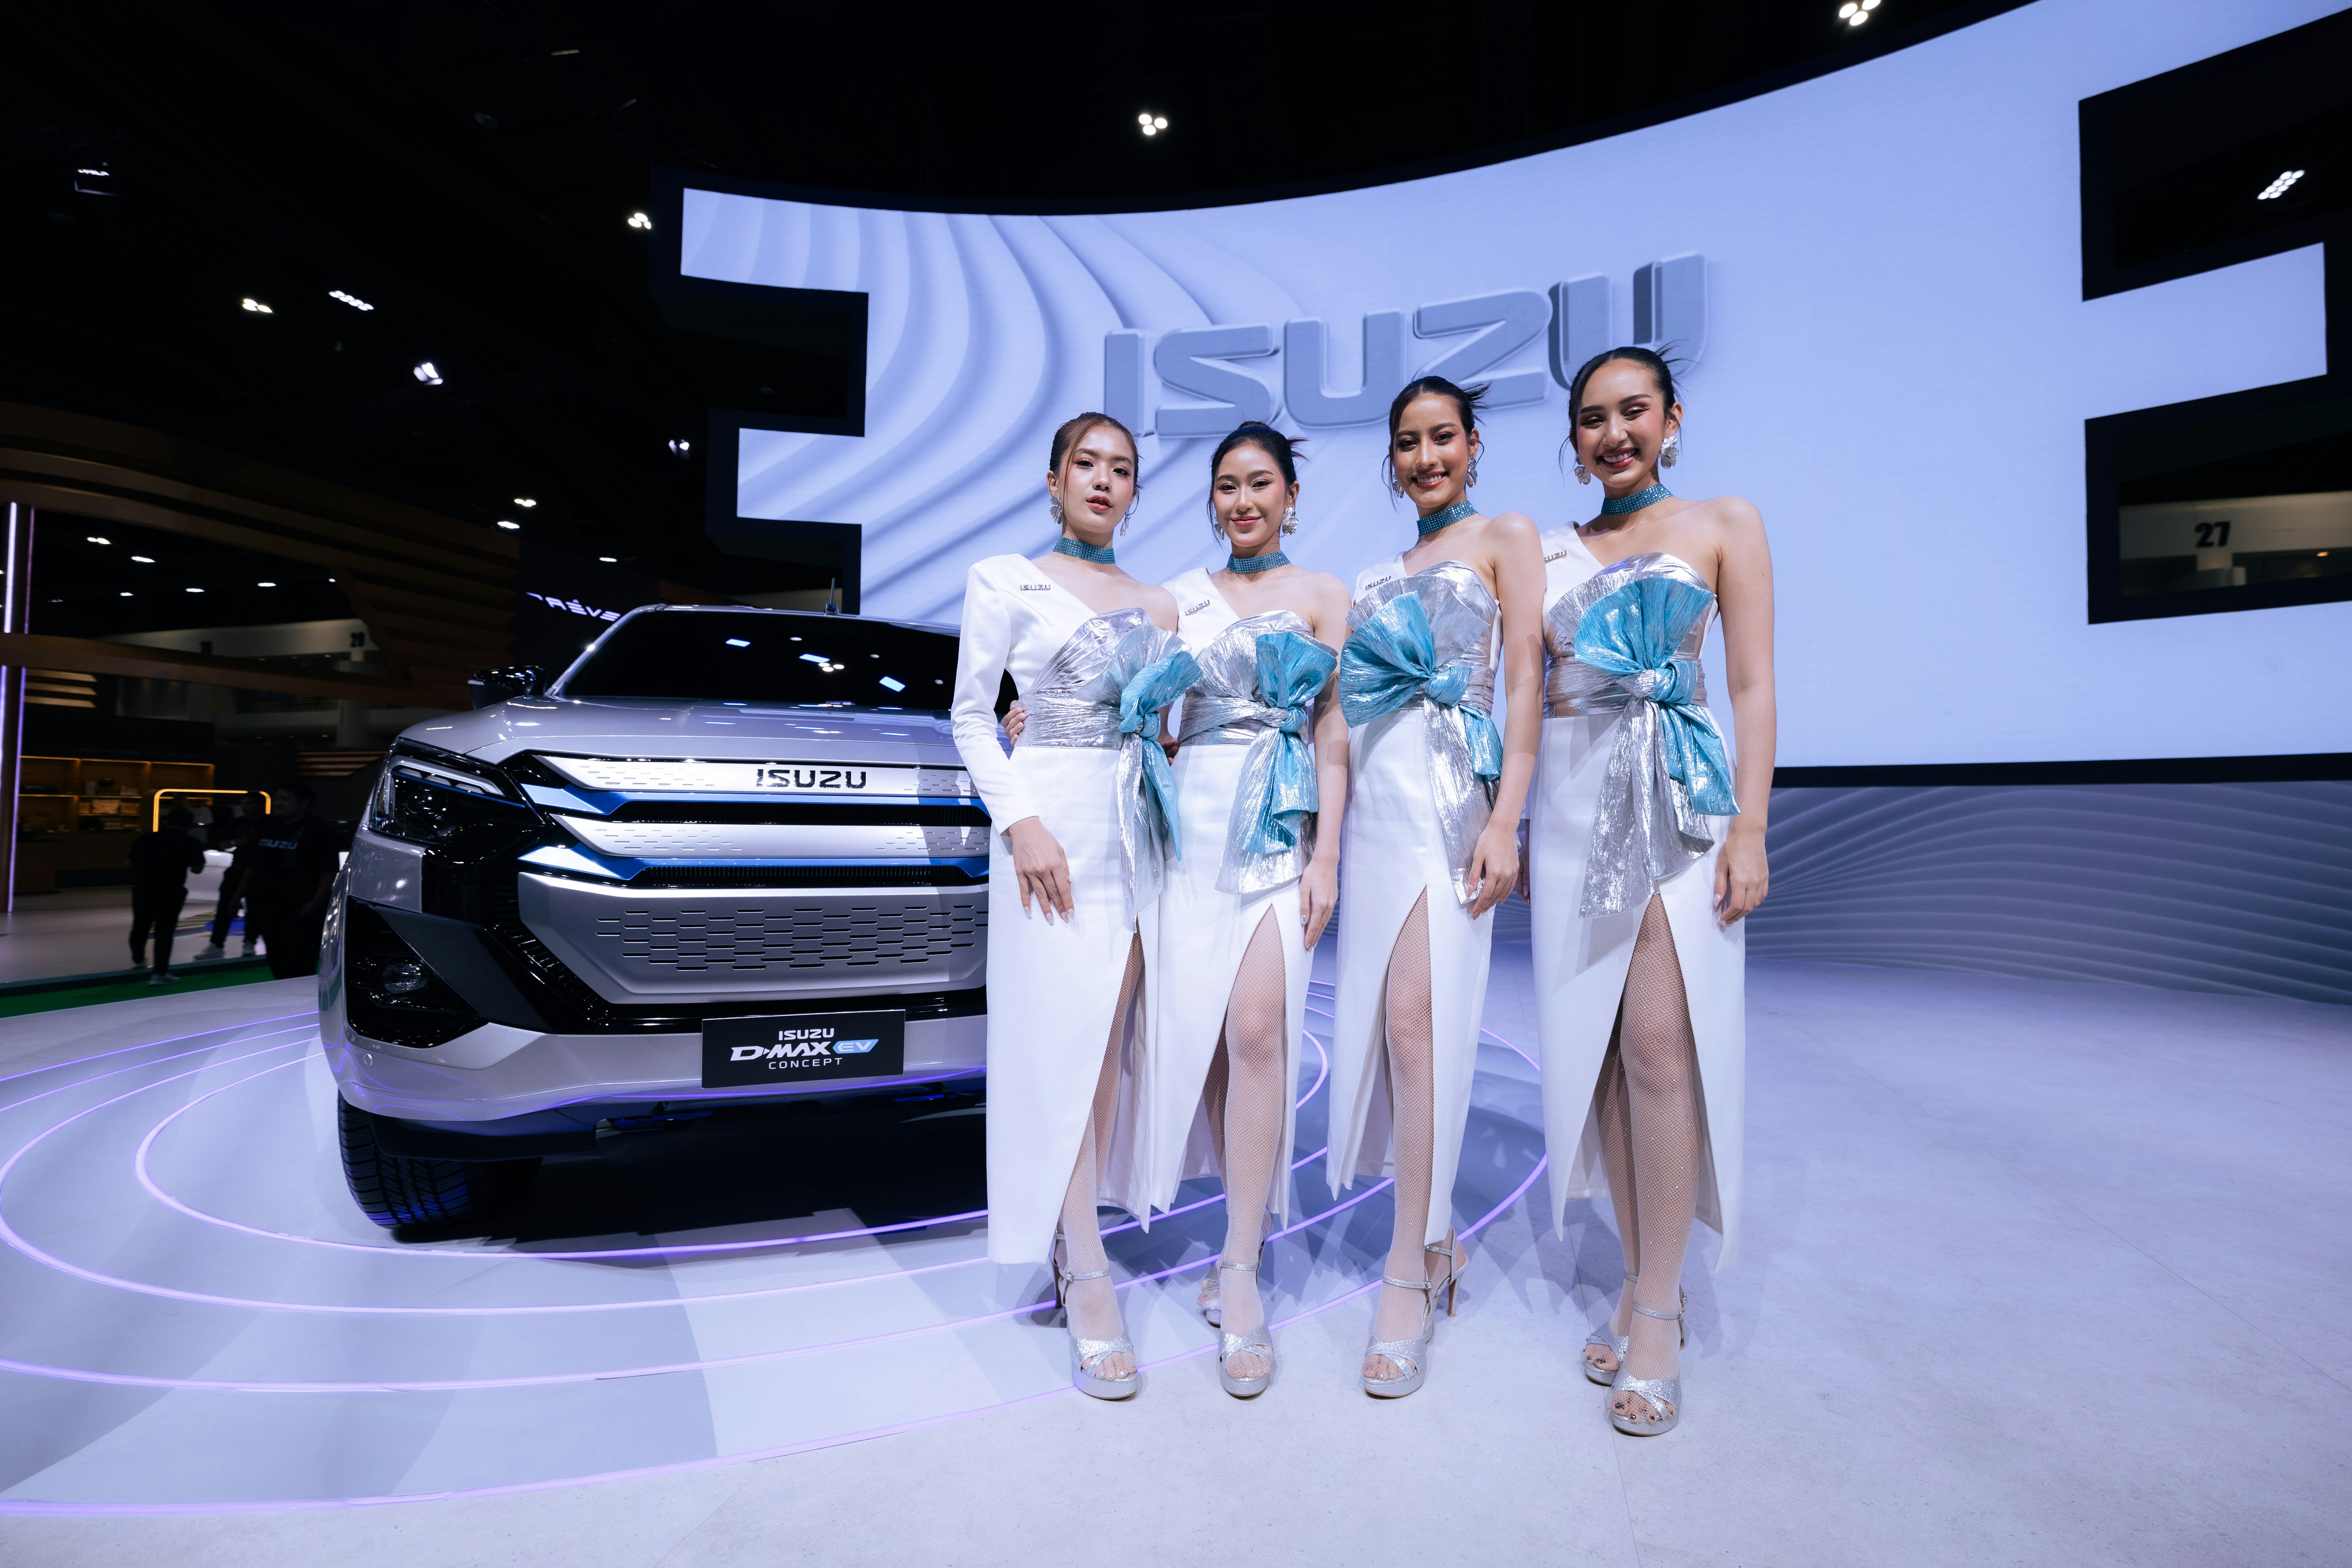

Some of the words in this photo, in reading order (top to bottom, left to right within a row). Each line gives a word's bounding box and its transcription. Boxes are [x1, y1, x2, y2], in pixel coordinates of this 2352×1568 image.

[1104, 251, 1707, 438] ISUZU
[2195, 521, 2230, 548] 27
[1544, 550, 1567, 563] UZU
[1365, 576, 1391, 591] ISUZU
[1184, 600, 1210, 616] ISUZU
[756, 769, 866, 789] ISUZU
[258, 838, 299, 849] ISUZU
[779, 1028, 834, 1040] ISUZU
[837, 1041, 873, 1052] EV
[769, 1058, 842, 1069] CONCEPT
